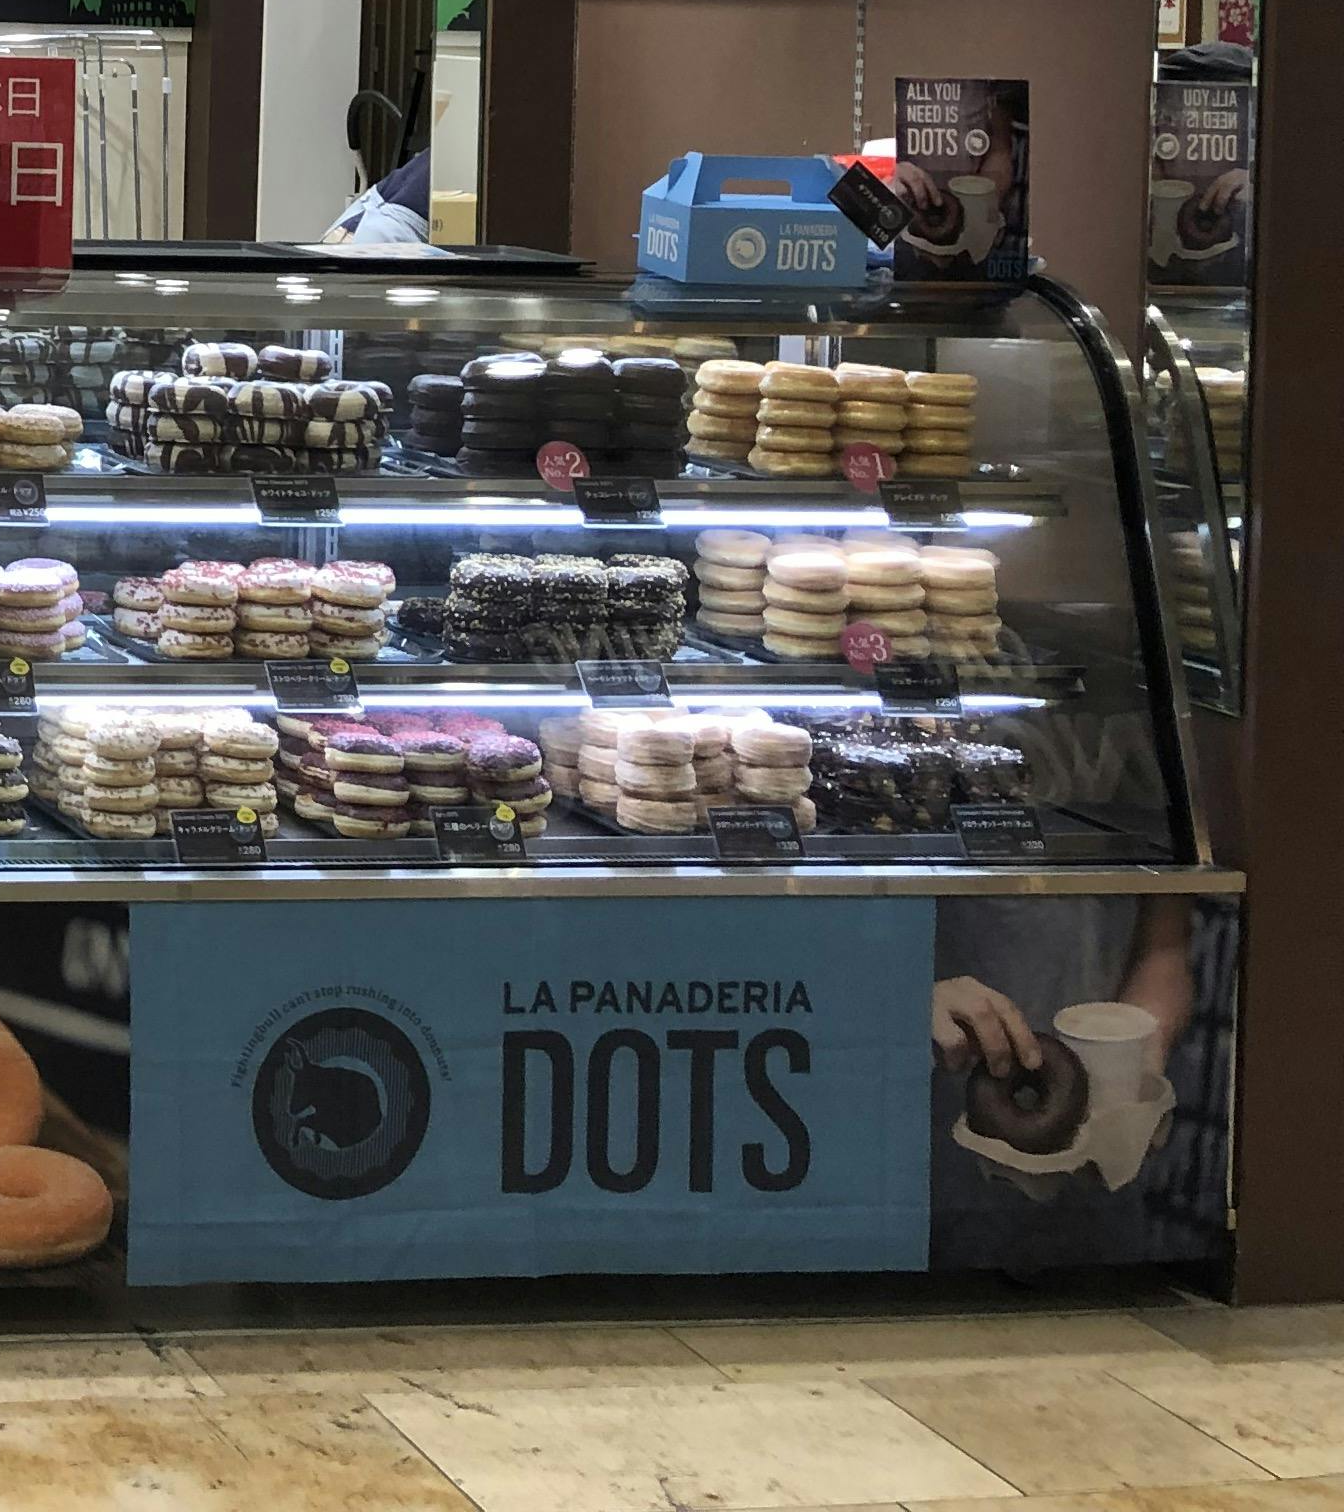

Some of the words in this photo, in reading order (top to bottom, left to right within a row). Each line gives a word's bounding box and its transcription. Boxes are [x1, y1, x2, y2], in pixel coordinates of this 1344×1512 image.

[906, 83, 932, 101] ALL
[934, 83, 960, 102] YOU
[907, 105, 942, 123] NEED
[945, 105, 958, 123] IS
[907, 128, 958, 156] DOTS
[647, 226, 678, 262] DOTS
[777, 239, 837, 271] DOTS
[315, 985, 343, 998] stop
[346, 985, 397, 1011] rushing
[502, 980, 557, 1015] LA
[569, 980, 813, 1015] PANADERIA
[501, 1028, 812, 1195] DOTS
